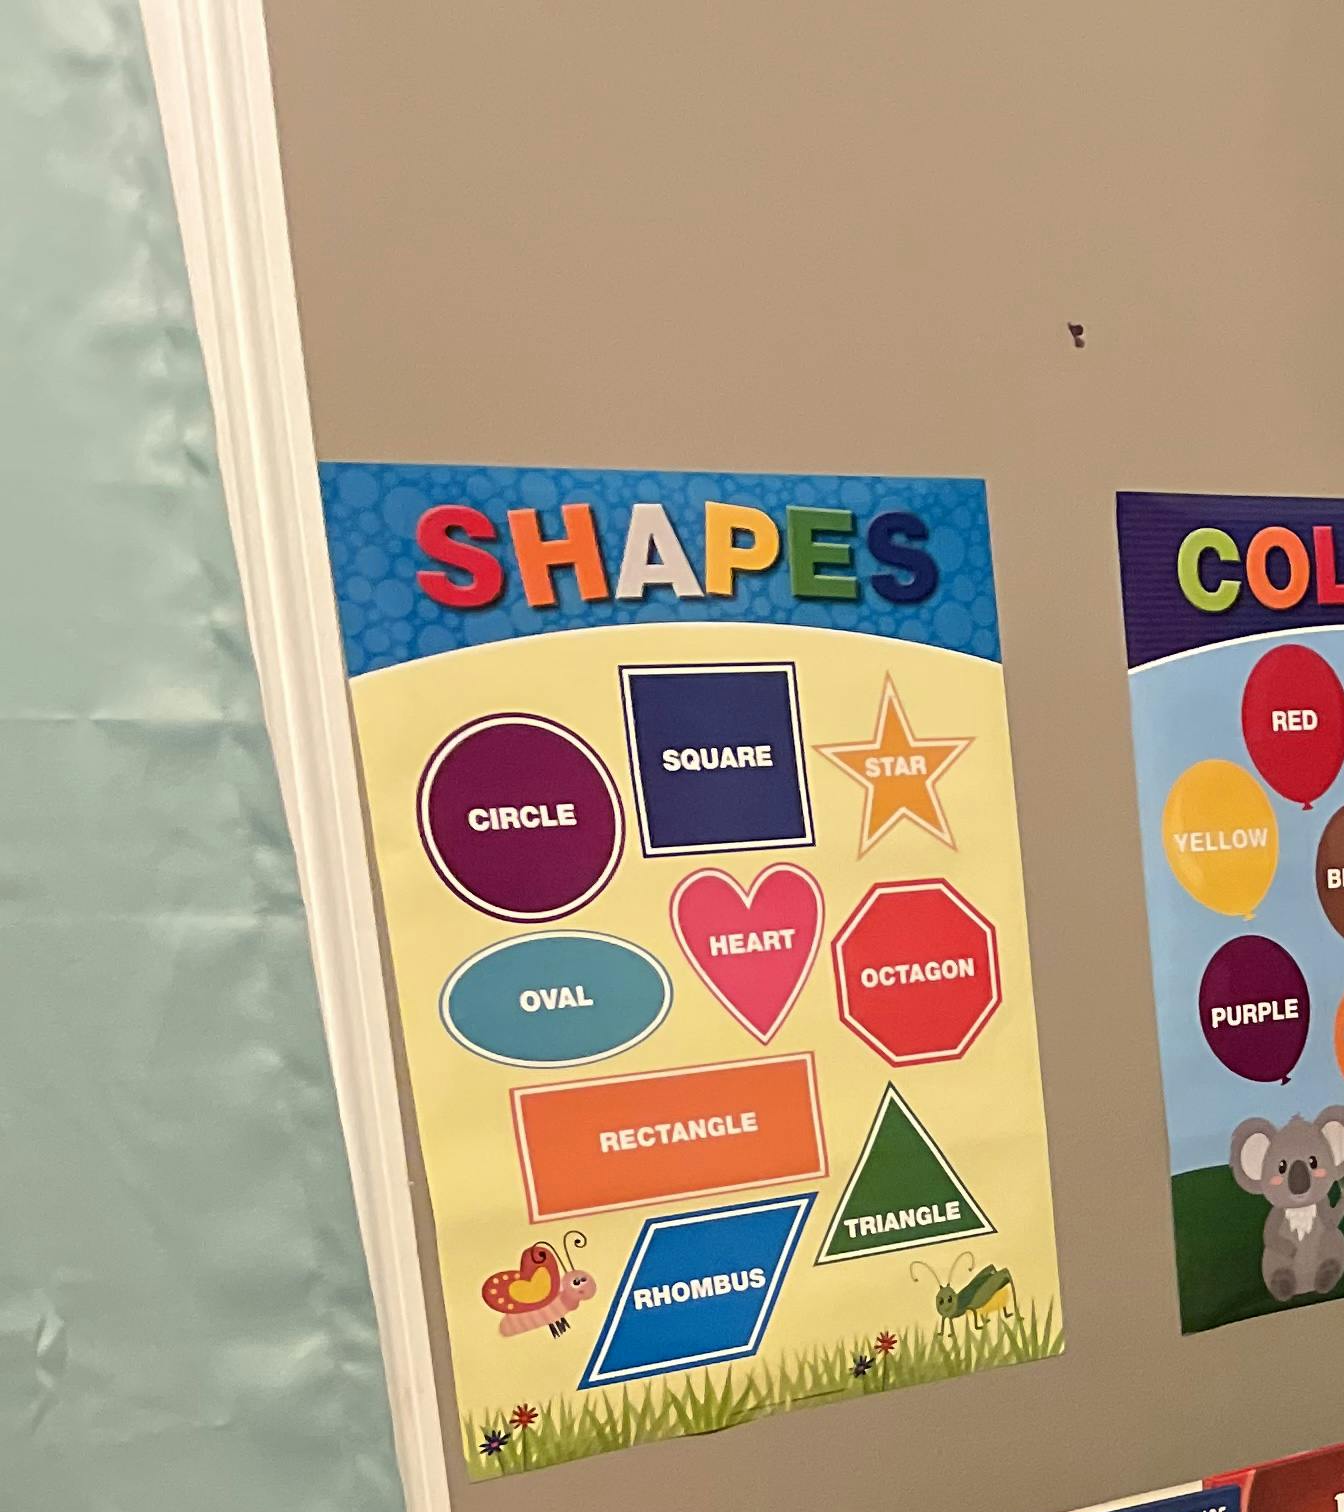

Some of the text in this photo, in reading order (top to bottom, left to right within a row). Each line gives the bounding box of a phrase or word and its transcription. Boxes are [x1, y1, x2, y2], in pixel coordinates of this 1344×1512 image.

[415, 500, 940, 608] SHAPES
[1271, 709, 1319, 732] RED
[662, 745, 773, 772] SQUARE
[864, 756, 927, 779] STAR
[468, 803, 578, 832] CIRCLE
[1173, 827, 1269, 854] YELLOW
[709, 929, 796, 956] HEART
[860, 957, 976, 988] OCTAGON
[519, 985, 594, 1013] OVAL
[1211, 998, 1300, 1029] PURPLE
[600, 1111, 758, 1153] RECTANGLE
[844, 1201, 961, 1239] TRIANGLE
[633, 1267, 766, 1311] RHOMBUS
